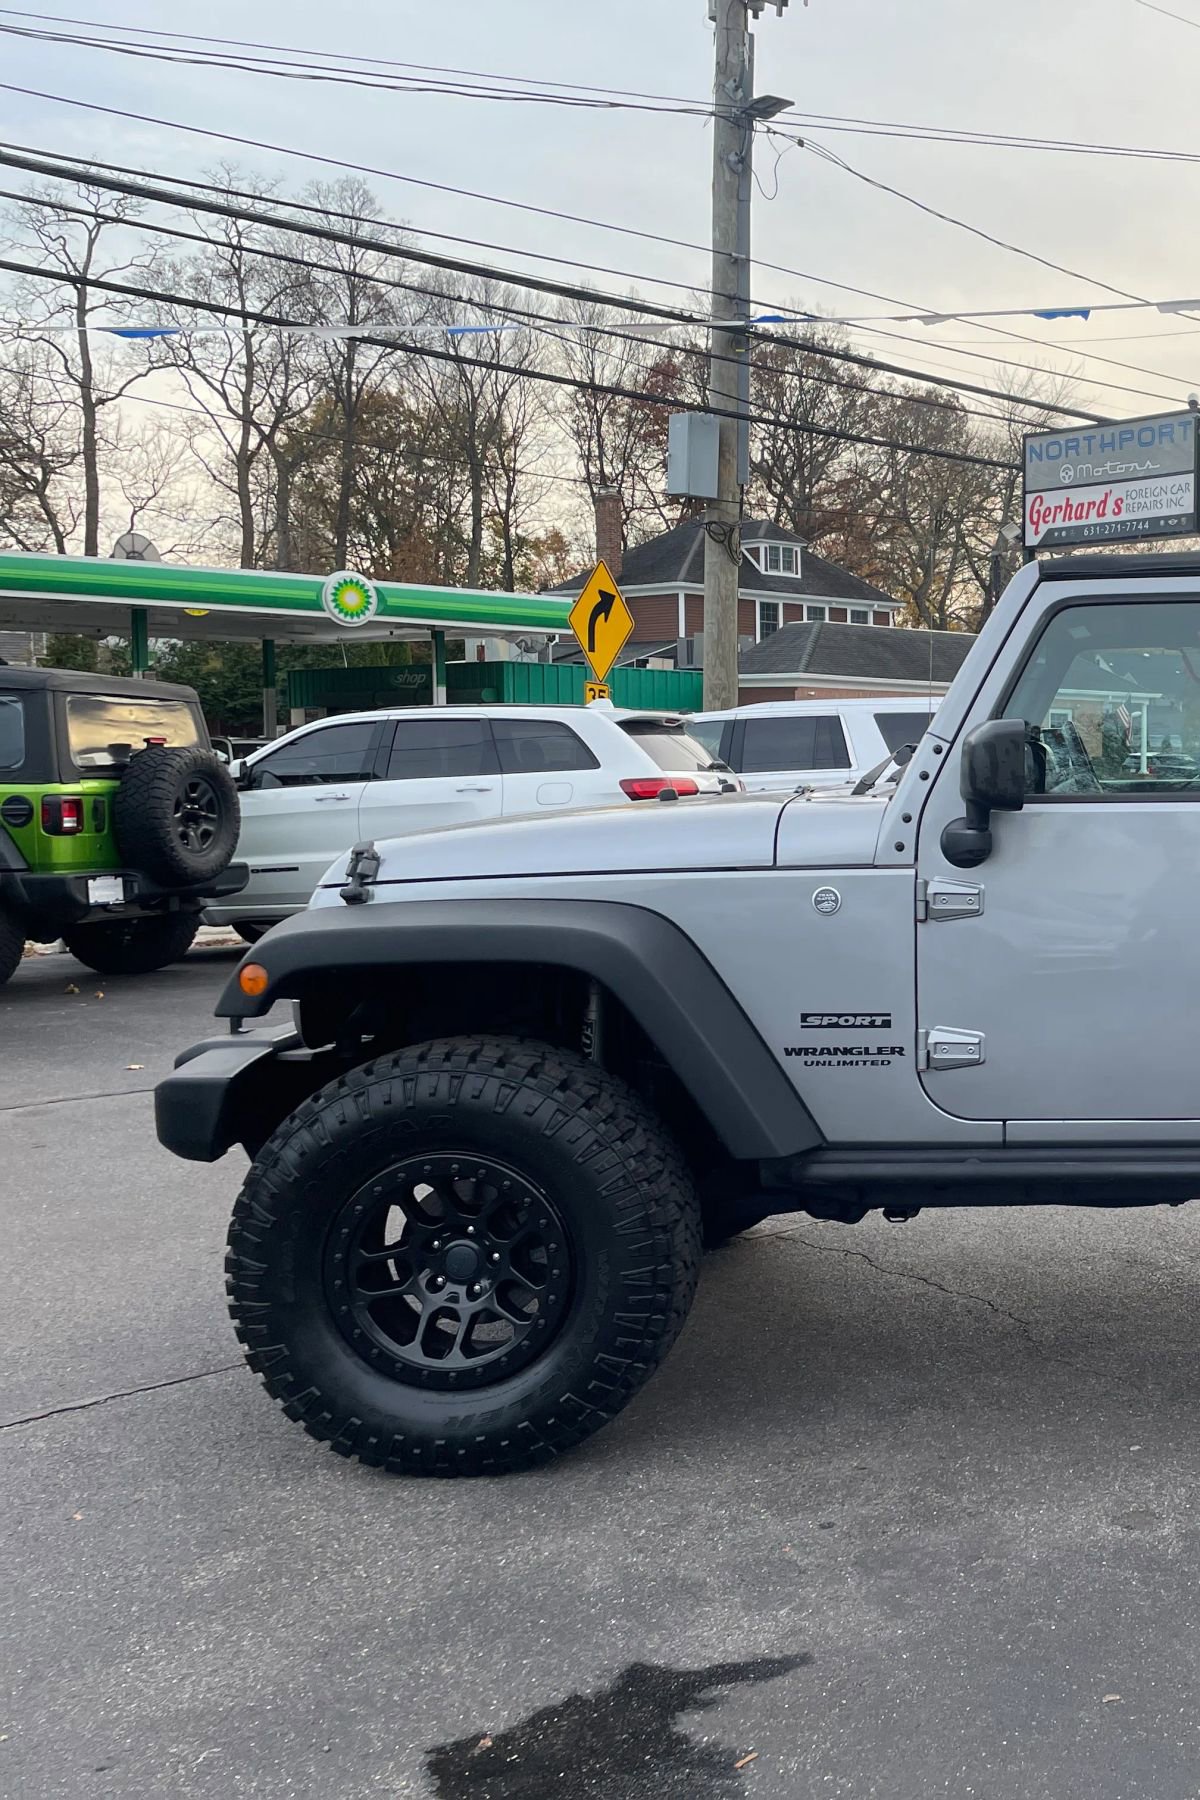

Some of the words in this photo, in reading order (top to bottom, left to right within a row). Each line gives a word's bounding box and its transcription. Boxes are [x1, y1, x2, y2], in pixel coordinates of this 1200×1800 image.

[1029, 420, 1193, 463] NORTHPORT
[1076, 460, 1160, 479] Motors
[1125, 485, 1168, 501] FOREIGN
[1170, 482, 1191, 495] CAR
[1029, 489, 1124, 536] Gerhard's
[1125, 499, 1164, 514] REPAIRS
[1166, 495, 1185, 509] INC
[1083, 519, 1149, 536] 631-271-7744
[394, 668, 426, 688] shop
[803, 1014, 891, 1027] SPORT
[783, 1045, 906, 1057] WRANGLER
[803, 1059, 892, 1067] UNLIMITED
